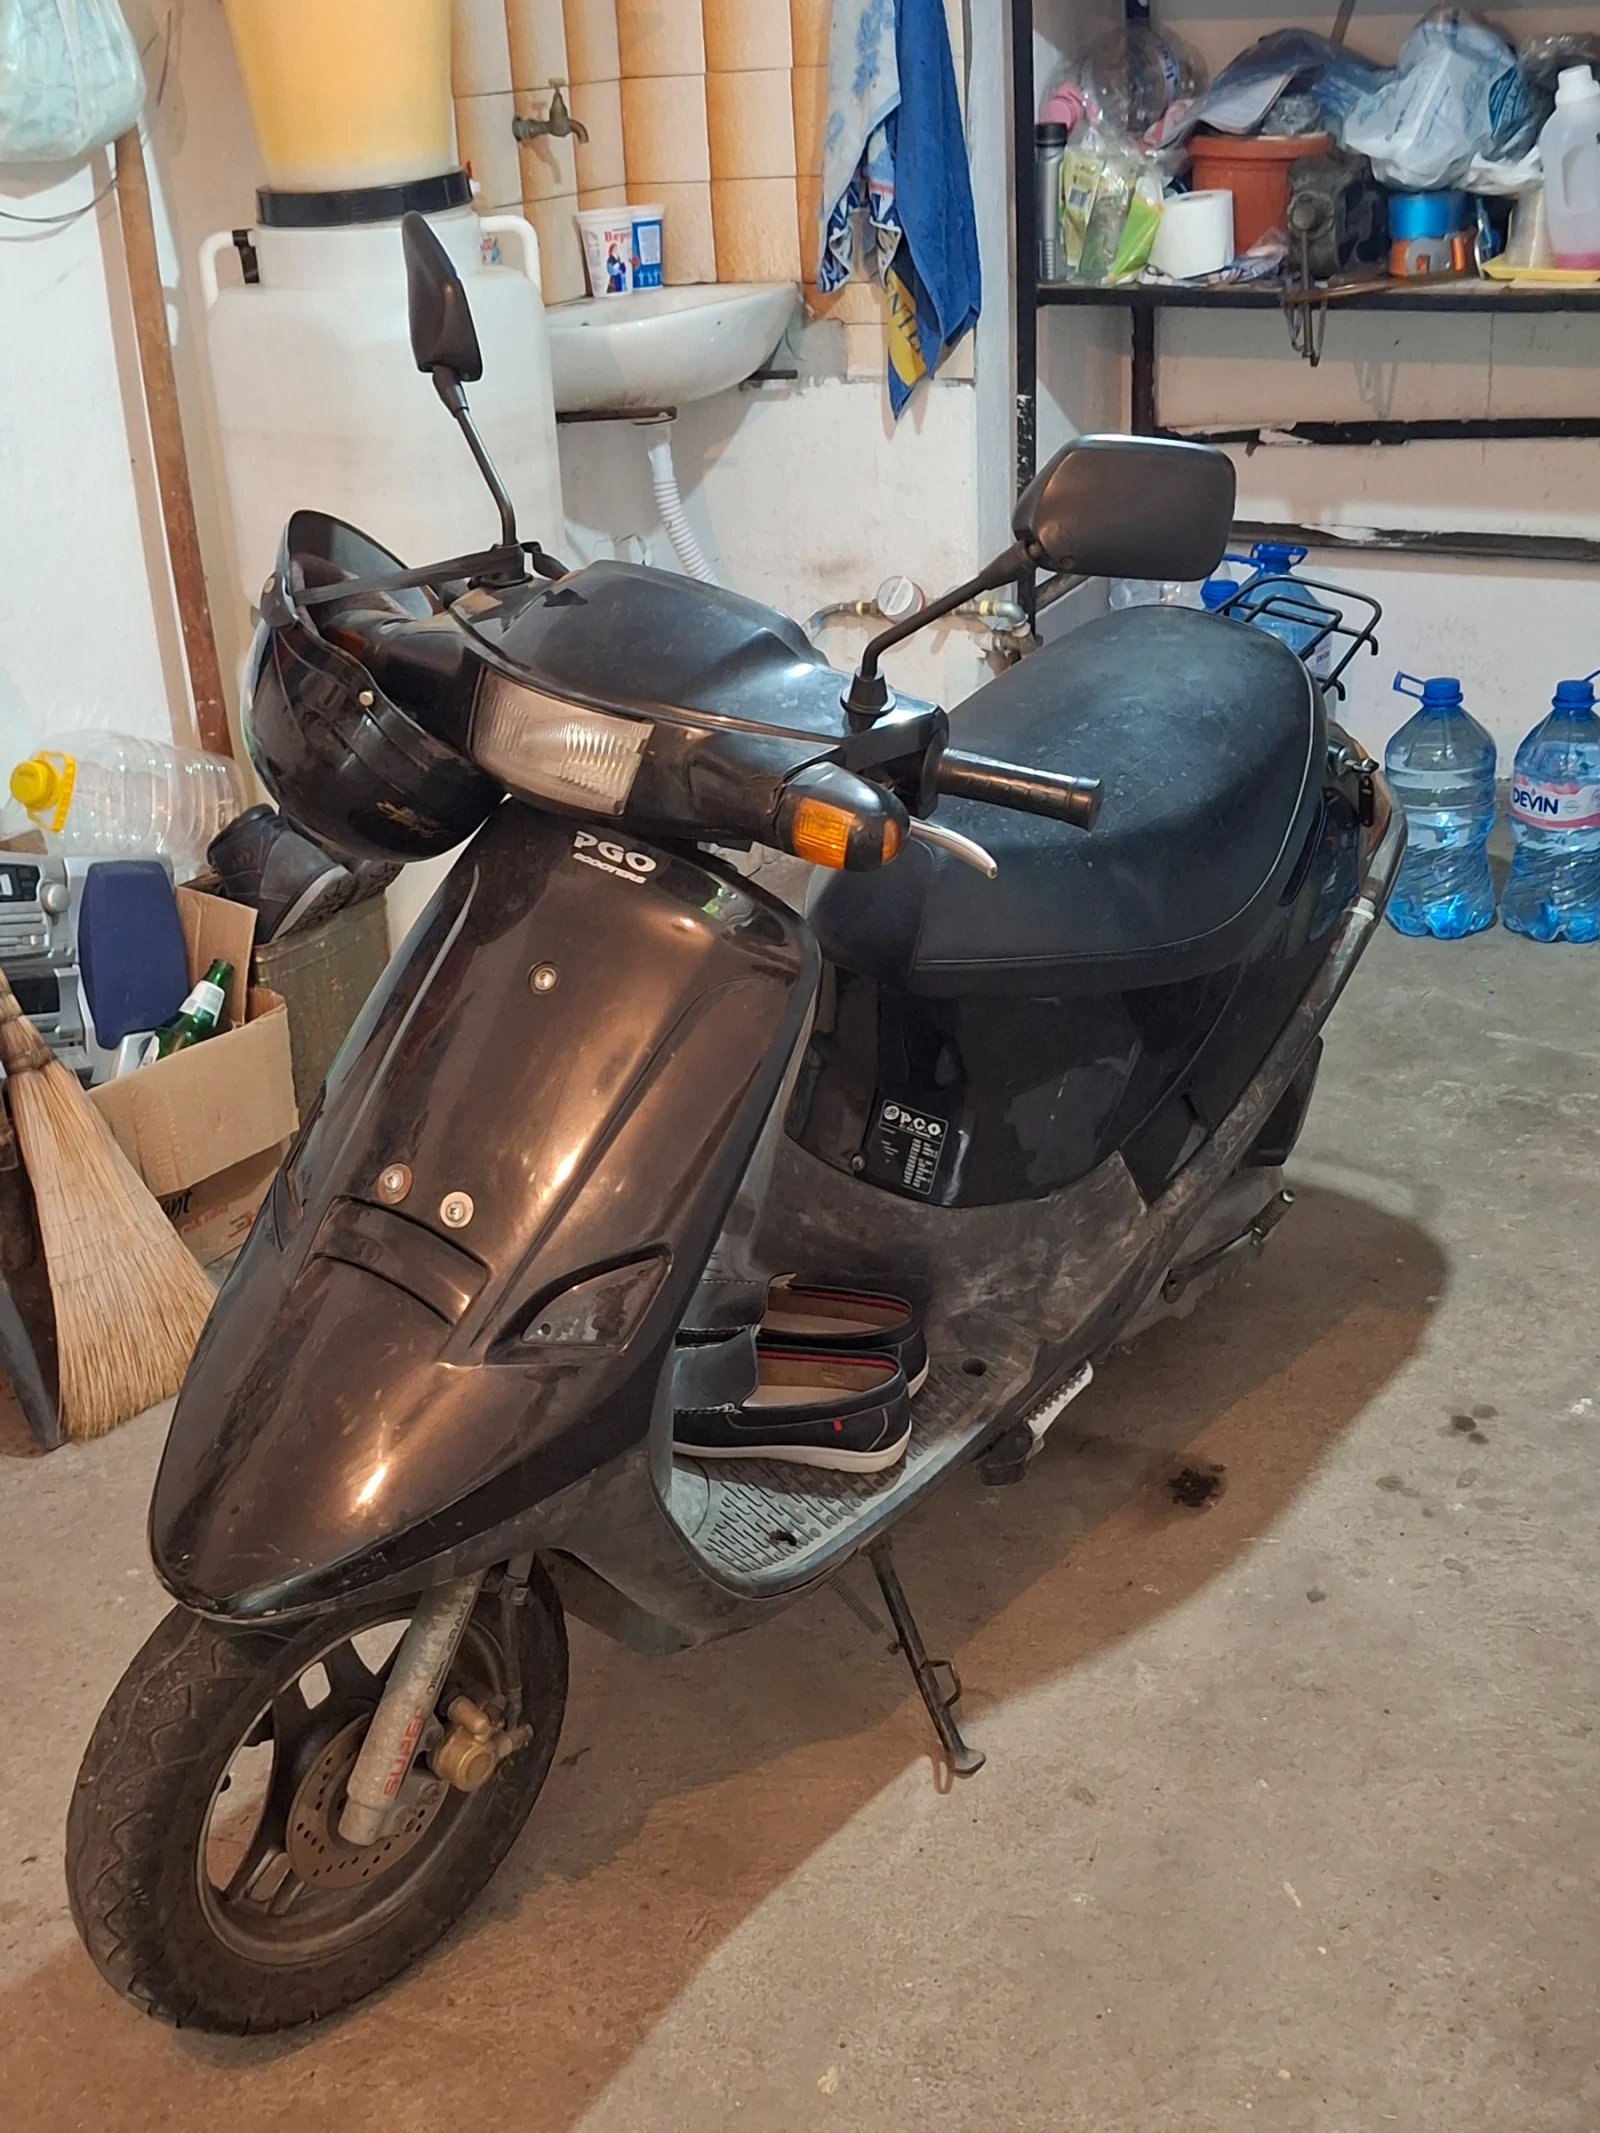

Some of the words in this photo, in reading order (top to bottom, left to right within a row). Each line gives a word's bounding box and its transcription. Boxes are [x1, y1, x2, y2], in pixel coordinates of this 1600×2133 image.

[1513, 787, 1559, 815] DEVIN
[573, 830, 657, 872] PGO
[572, 852, 647, 884] SCOOTERS
